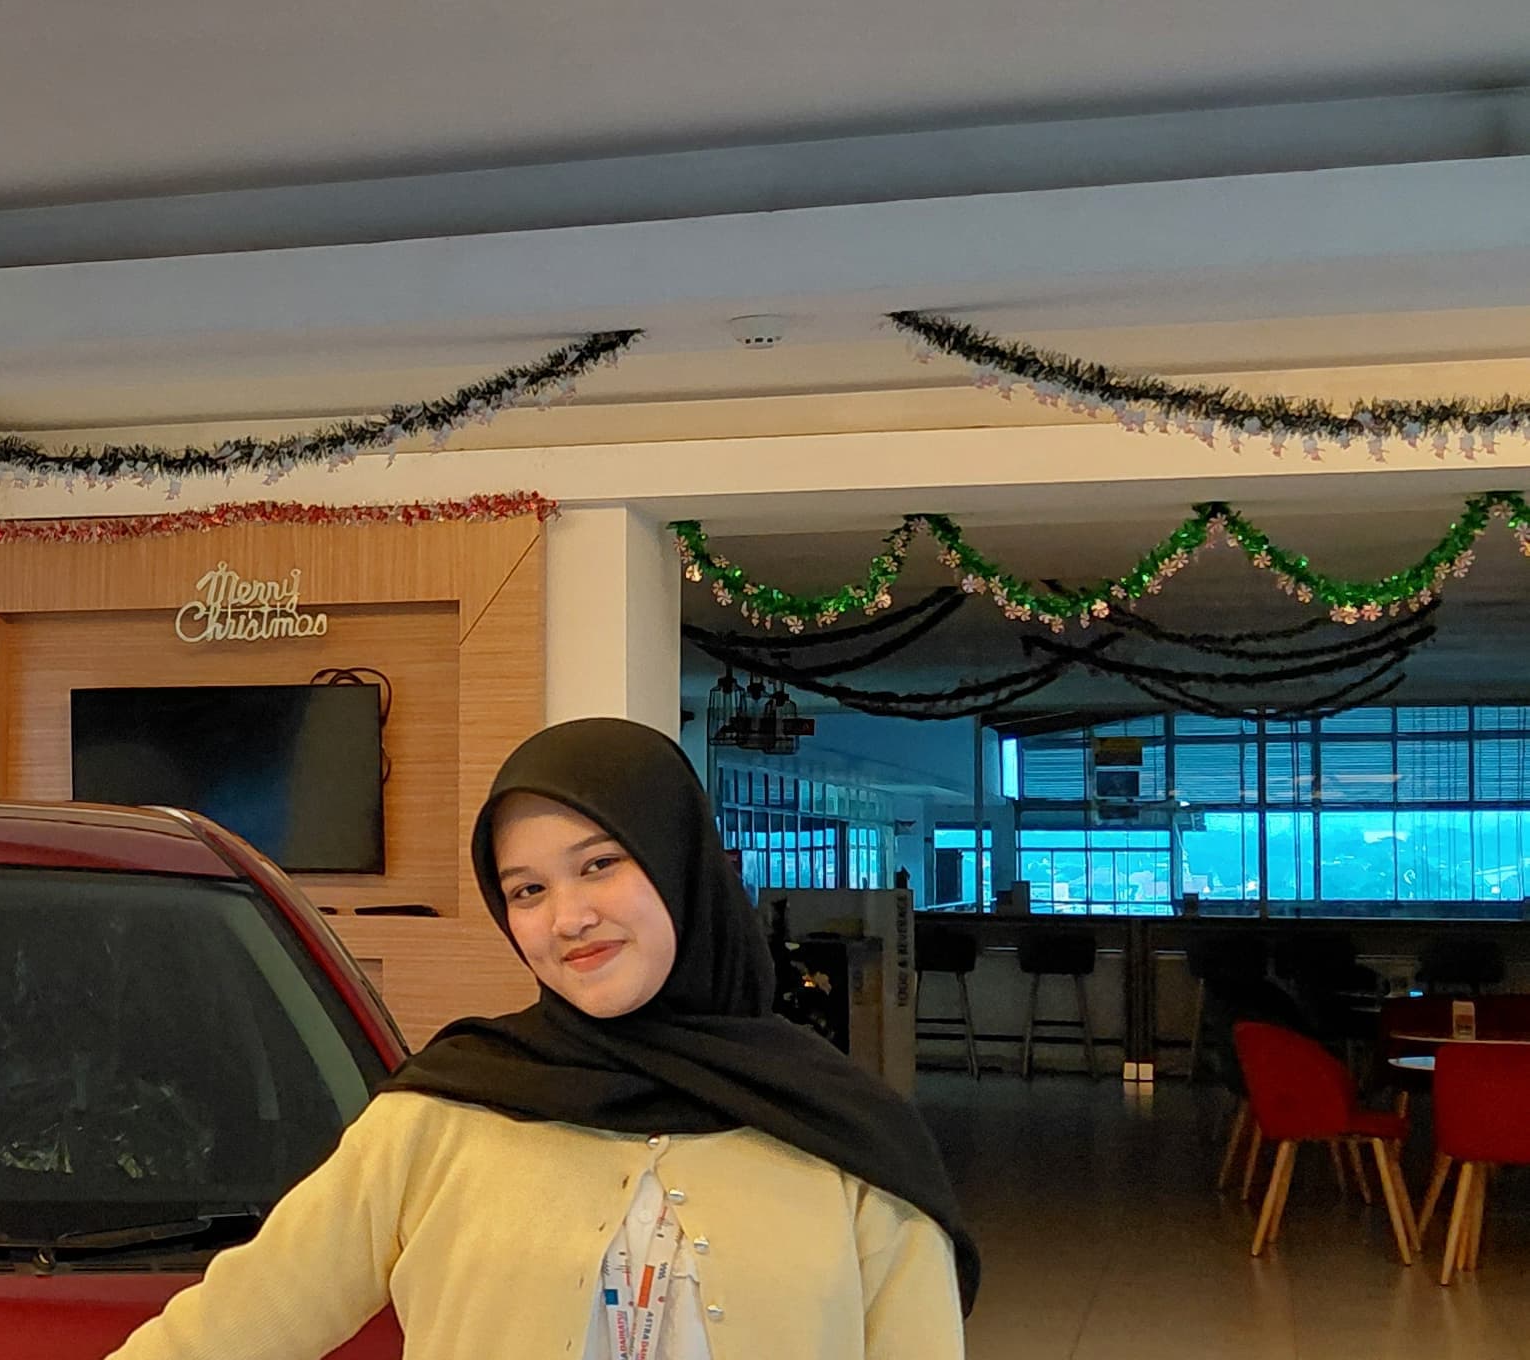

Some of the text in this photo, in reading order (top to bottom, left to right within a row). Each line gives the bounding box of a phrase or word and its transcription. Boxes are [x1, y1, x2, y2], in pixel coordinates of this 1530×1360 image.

[196, 560, 301, 613] Merry
[175, 601, 328, 643] Christmas
[643, 1311, 654, 1340] ASTRA
